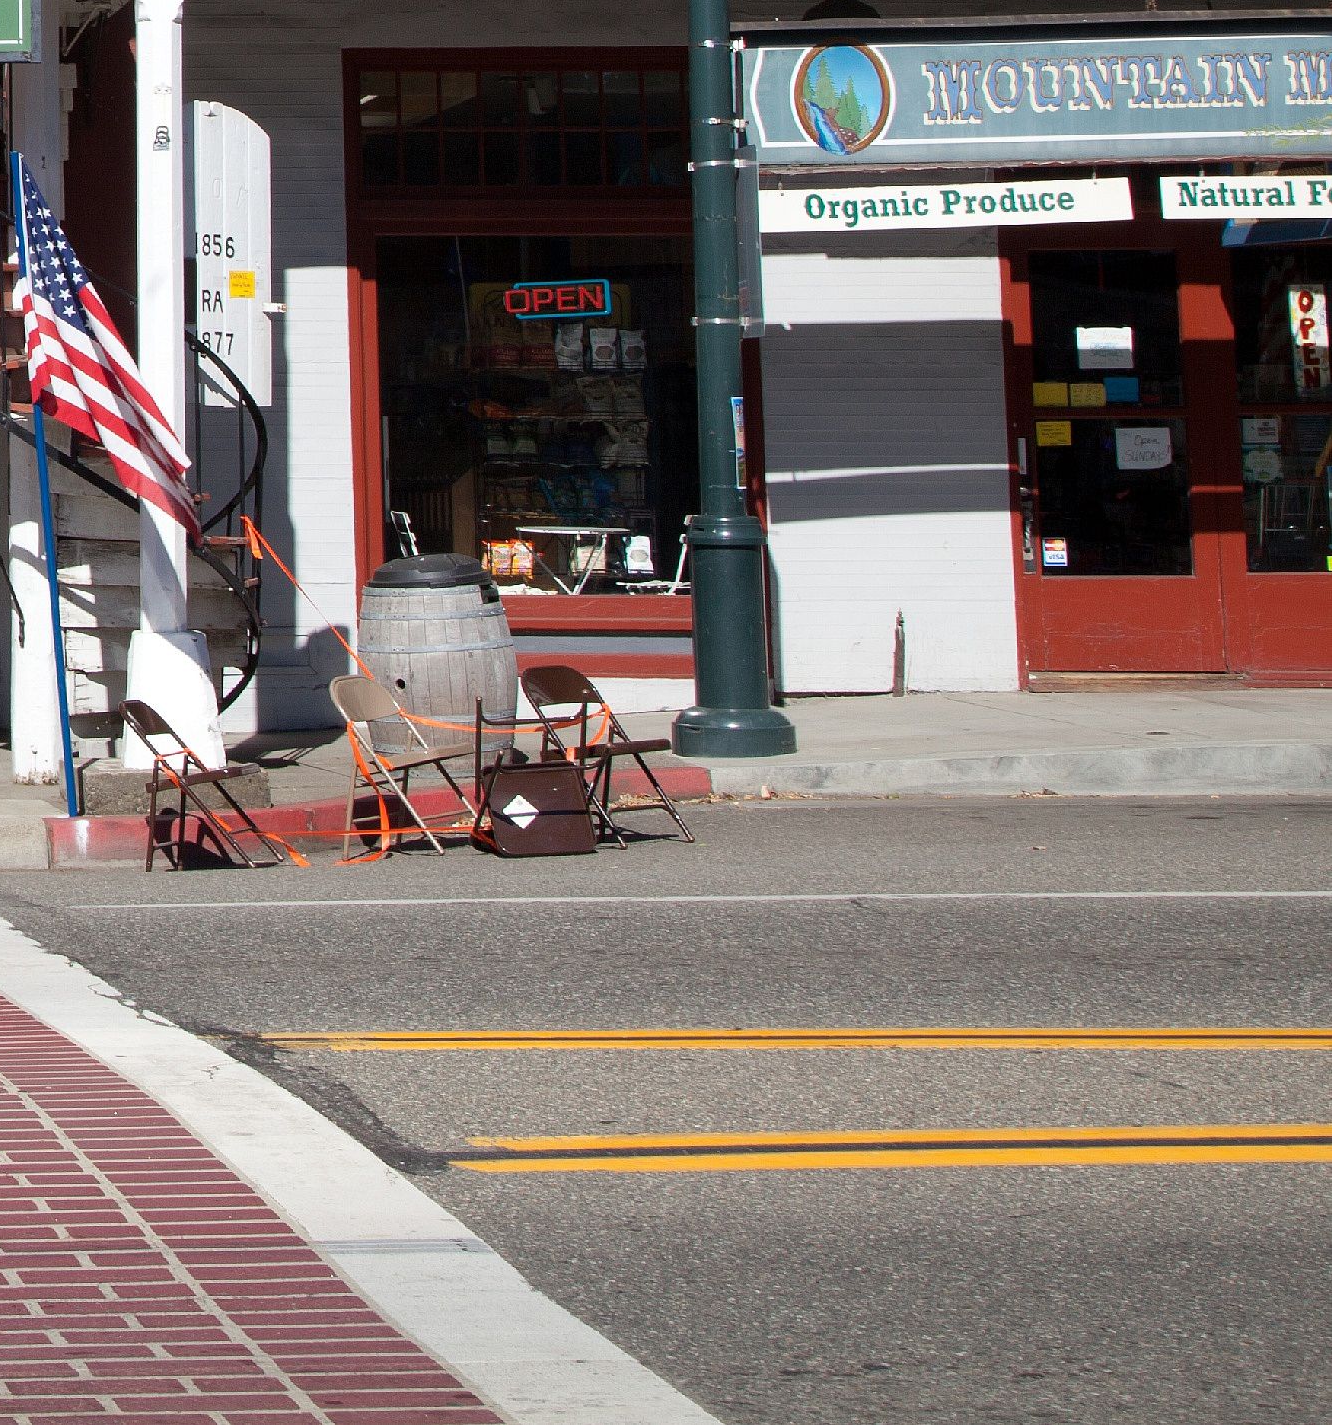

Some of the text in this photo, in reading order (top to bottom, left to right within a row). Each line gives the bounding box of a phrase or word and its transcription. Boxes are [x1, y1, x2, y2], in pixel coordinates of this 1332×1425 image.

[921, 52, 1273, 126] MOUNTAIN
[804, 187, 1075, 228] Organic Produce
[1177, 179, 1332, 207] Natural F
[504, 285, 605, 314] OPEN
[1296, 289, 1321, 388] OPEN
[1048, 551, 1065, 560] VISA
